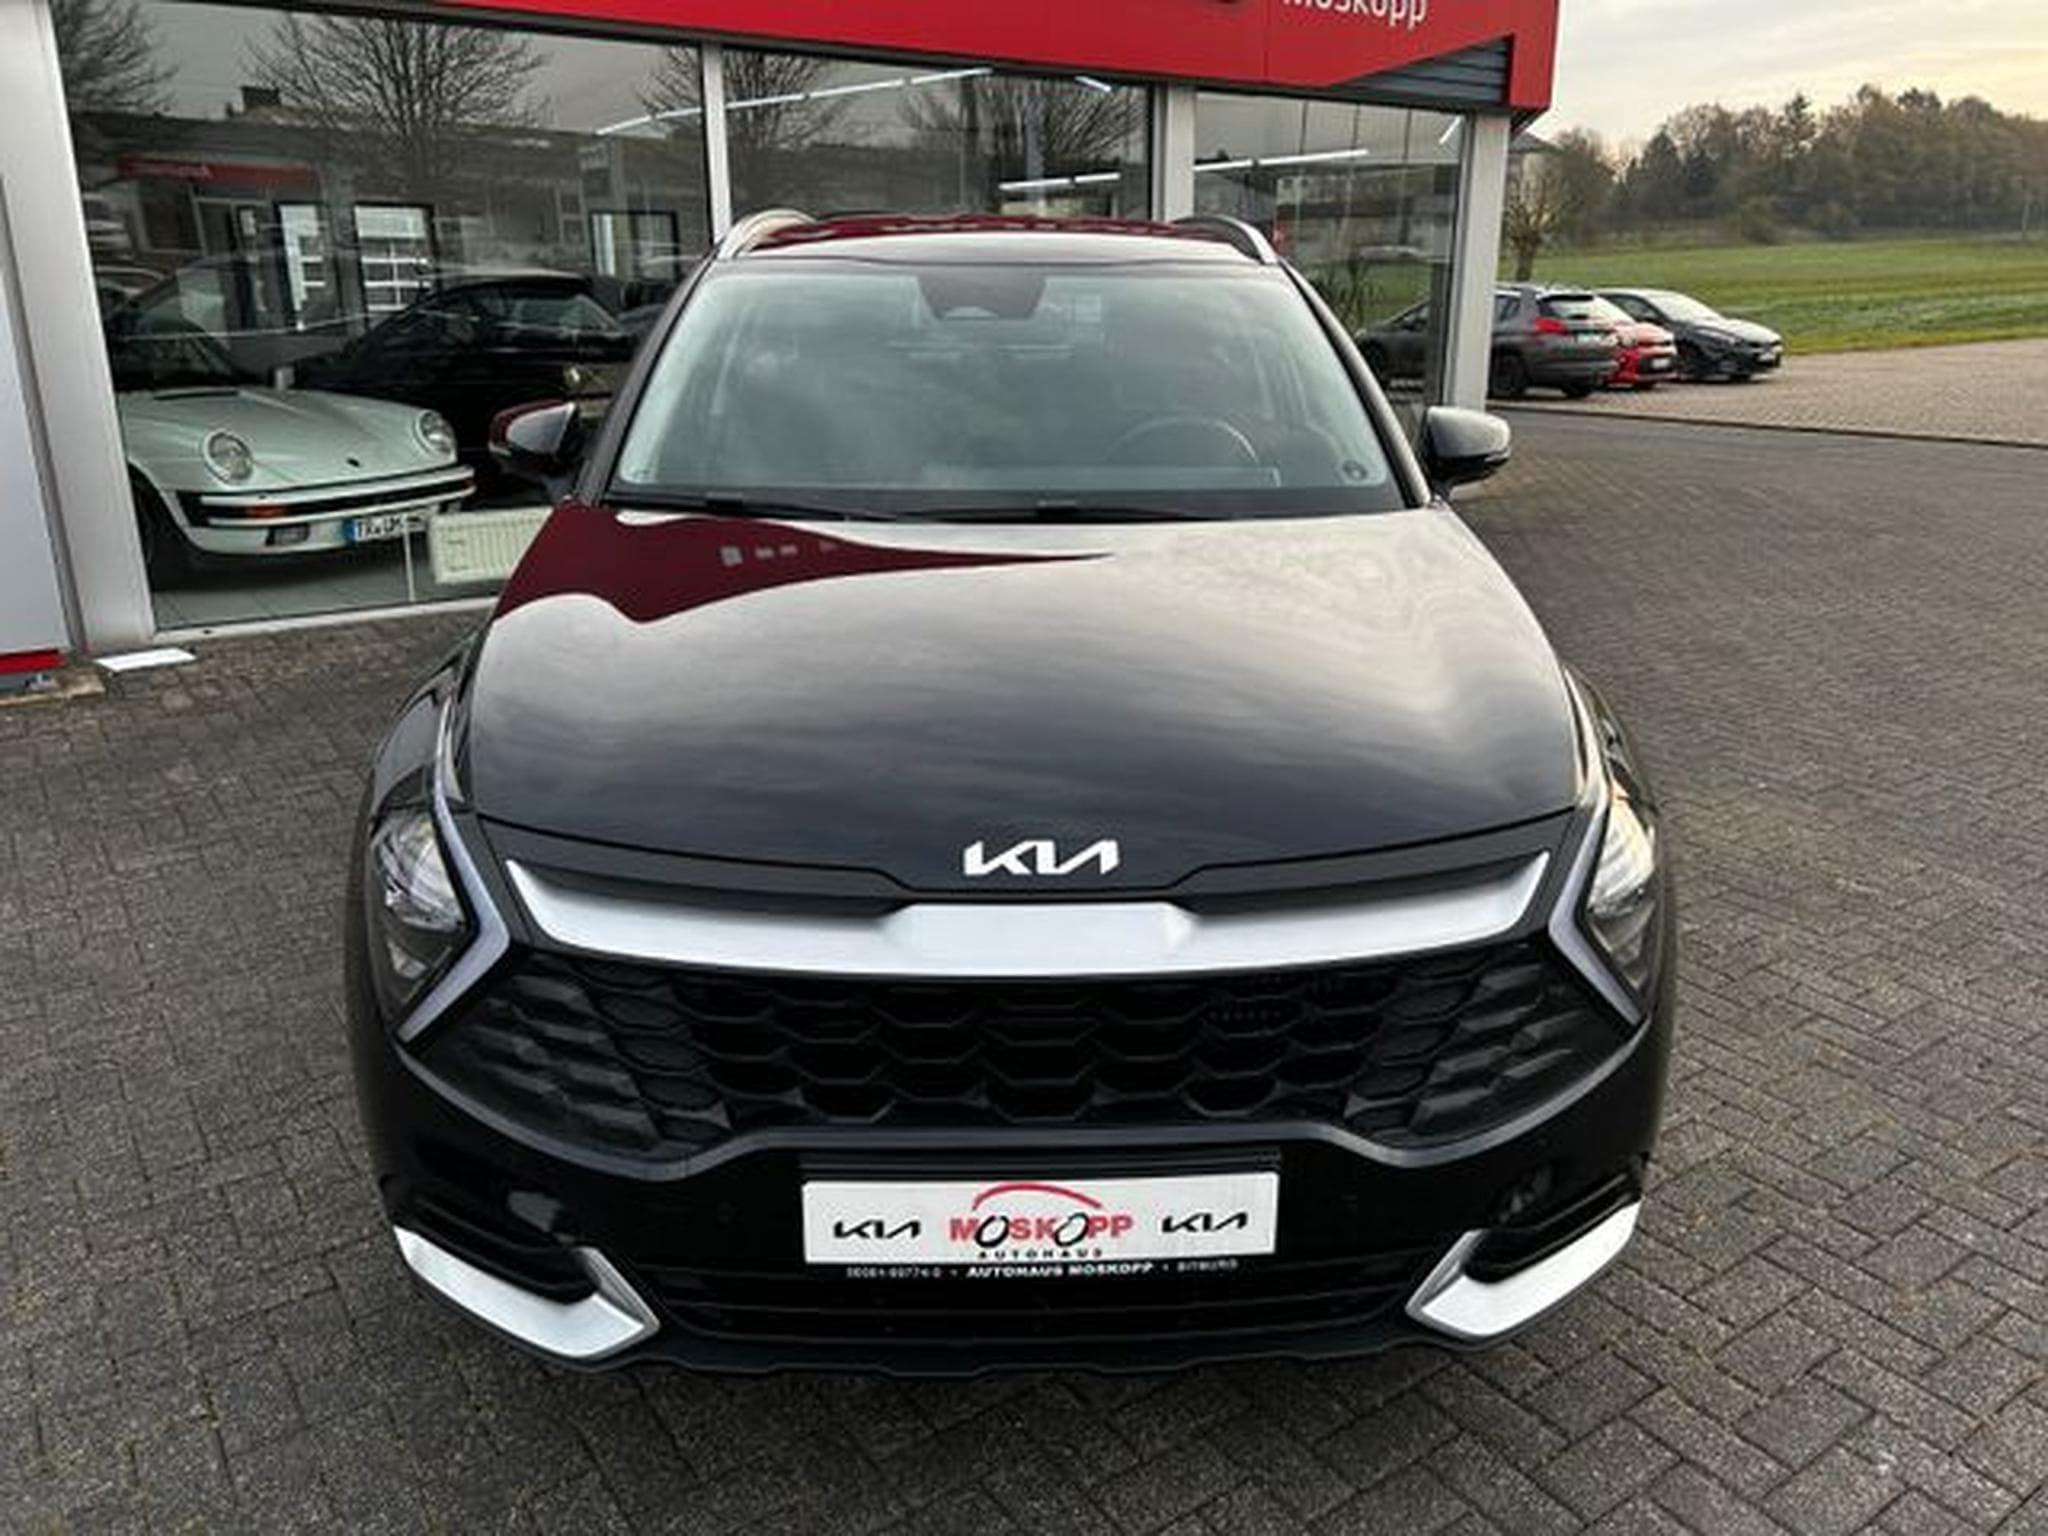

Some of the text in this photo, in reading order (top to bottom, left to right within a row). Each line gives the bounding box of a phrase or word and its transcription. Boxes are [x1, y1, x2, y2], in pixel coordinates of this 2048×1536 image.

[1282, 0, 1427, 30] skopp
[964, 839, 1119, 875] KIA
[834, 1219, 921, 1239] KIA
[950, 1212, 1134, 1248] MOSKOPP
[1162, 1212, 1248, 1233] KIA
[966, 1265, 1064, 1278] AUTOHAUS
[1067, 1262, 1154, 1276] MOSKOPP
